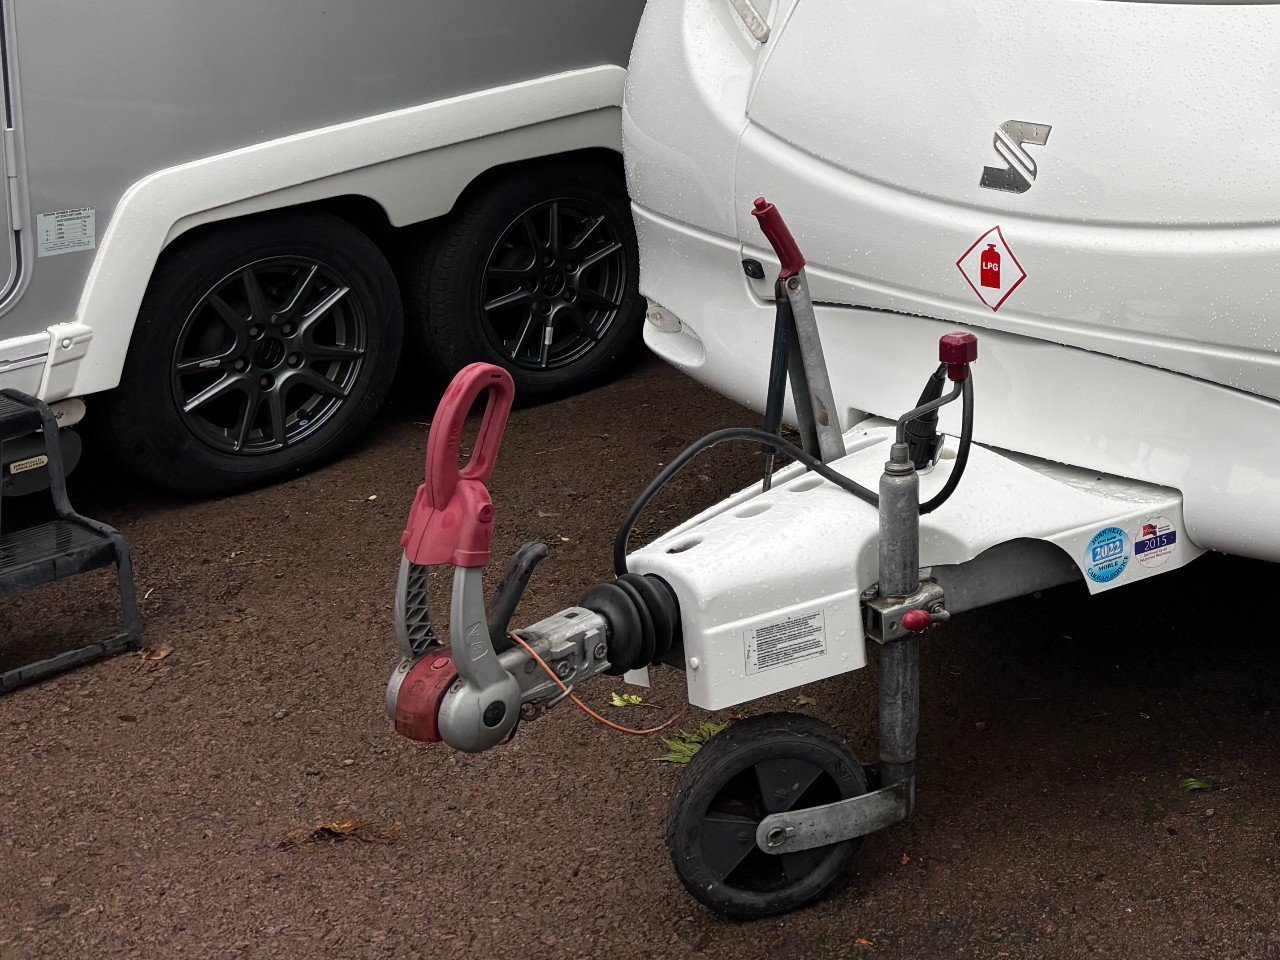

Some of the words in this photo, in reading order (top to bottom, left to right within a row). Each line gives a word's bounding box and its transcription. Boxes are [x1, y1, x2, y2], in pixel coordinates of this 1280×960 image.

[982, 261, 999, 272] LPG
[1095, 540, 1121, 560] 2022
[1144, 535, 1167, 551] 2015
